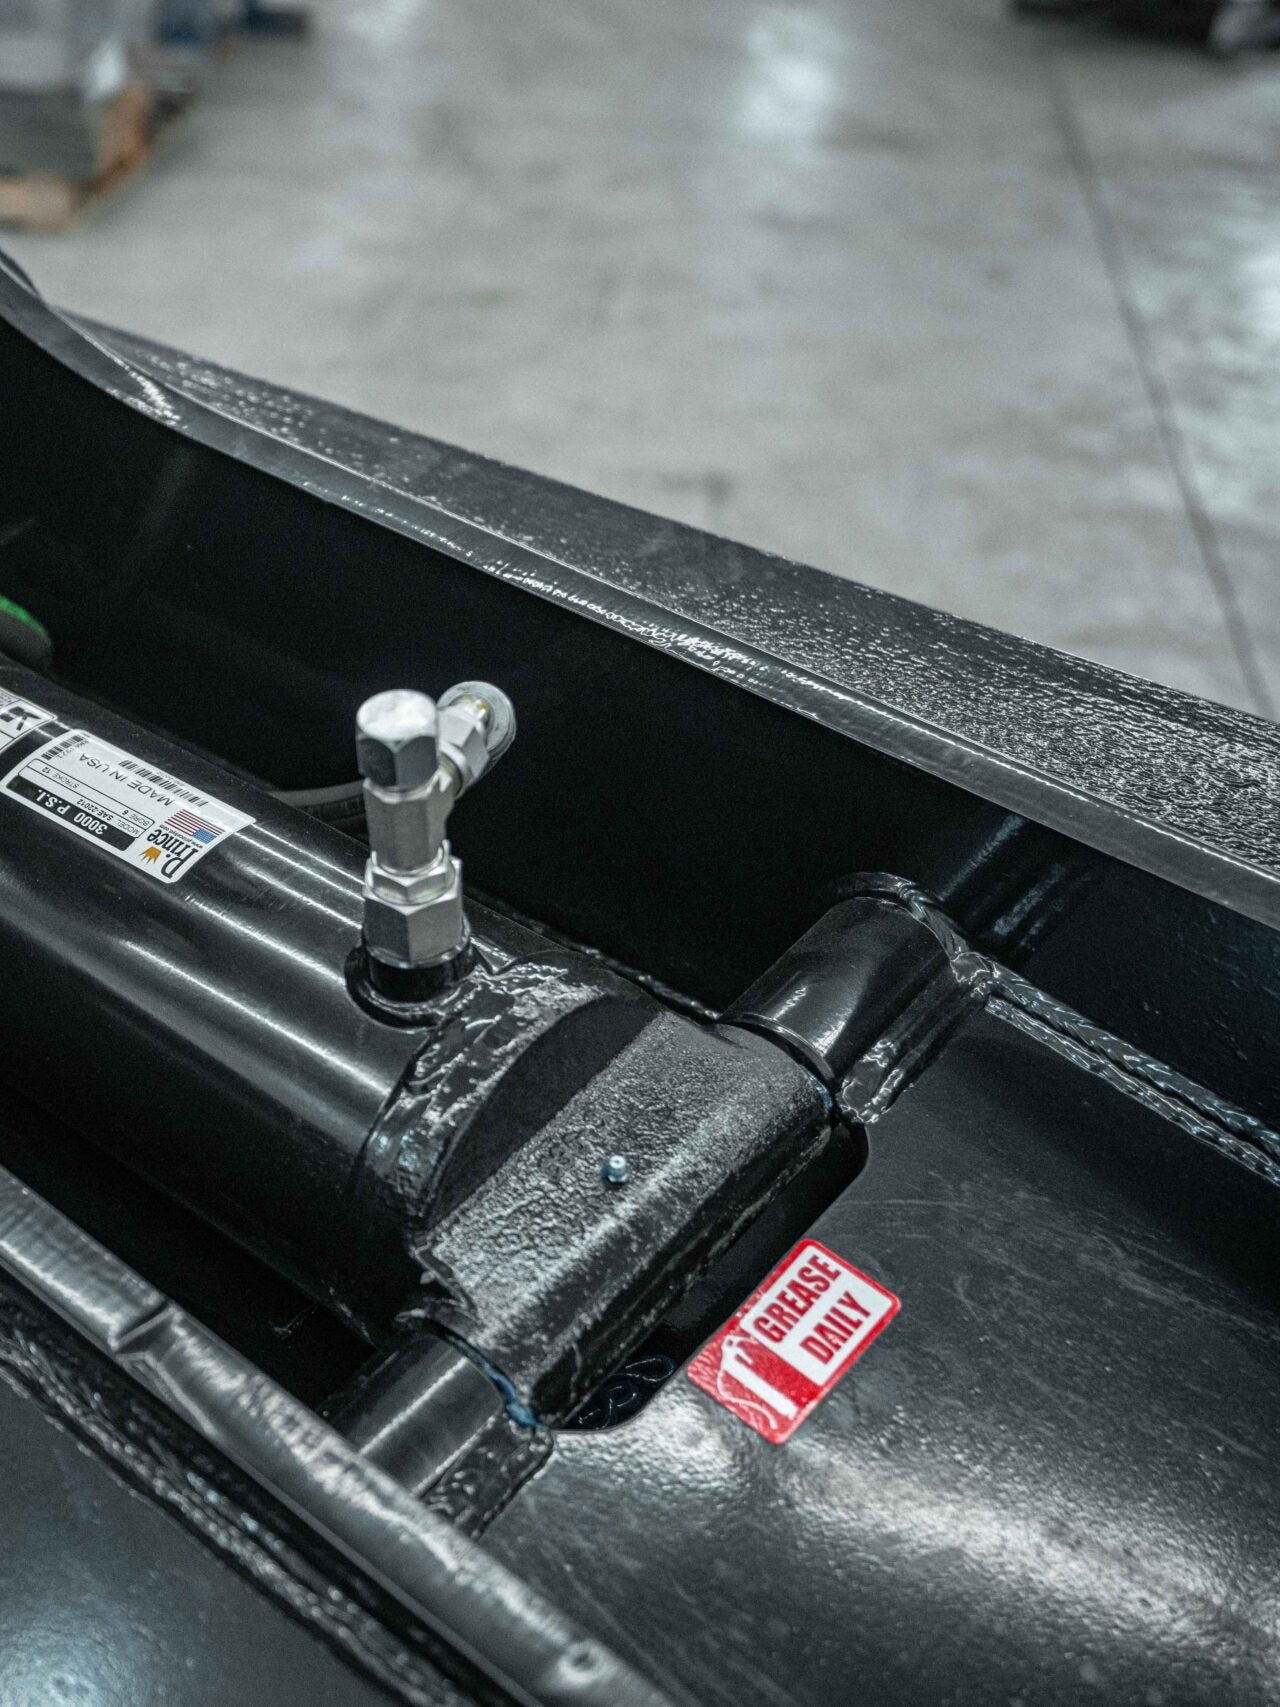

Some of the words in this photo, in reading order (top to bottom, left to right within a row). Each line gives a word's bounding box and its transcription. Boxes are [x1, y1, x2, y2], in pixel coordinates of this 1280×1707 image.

[41, 766, 51, 774] 12
[79, 752, 110, 773] USA
[52, 774, 80, 789] STROKE
[108, 770, 128, 782] IN
[36, 789, 71, 815] P.S.I.
[126, 779, 175, 806] MADE
[76, 799, 114, 821] SAE-22012
[129, 813, 150, 827] BORE
[73, 812, 108, 835] 3000
[146, 828, 199, 879] Prince
[753, 1254, 841, 1344] GREASE
[799, 1291, 872, 1365] DAILY
